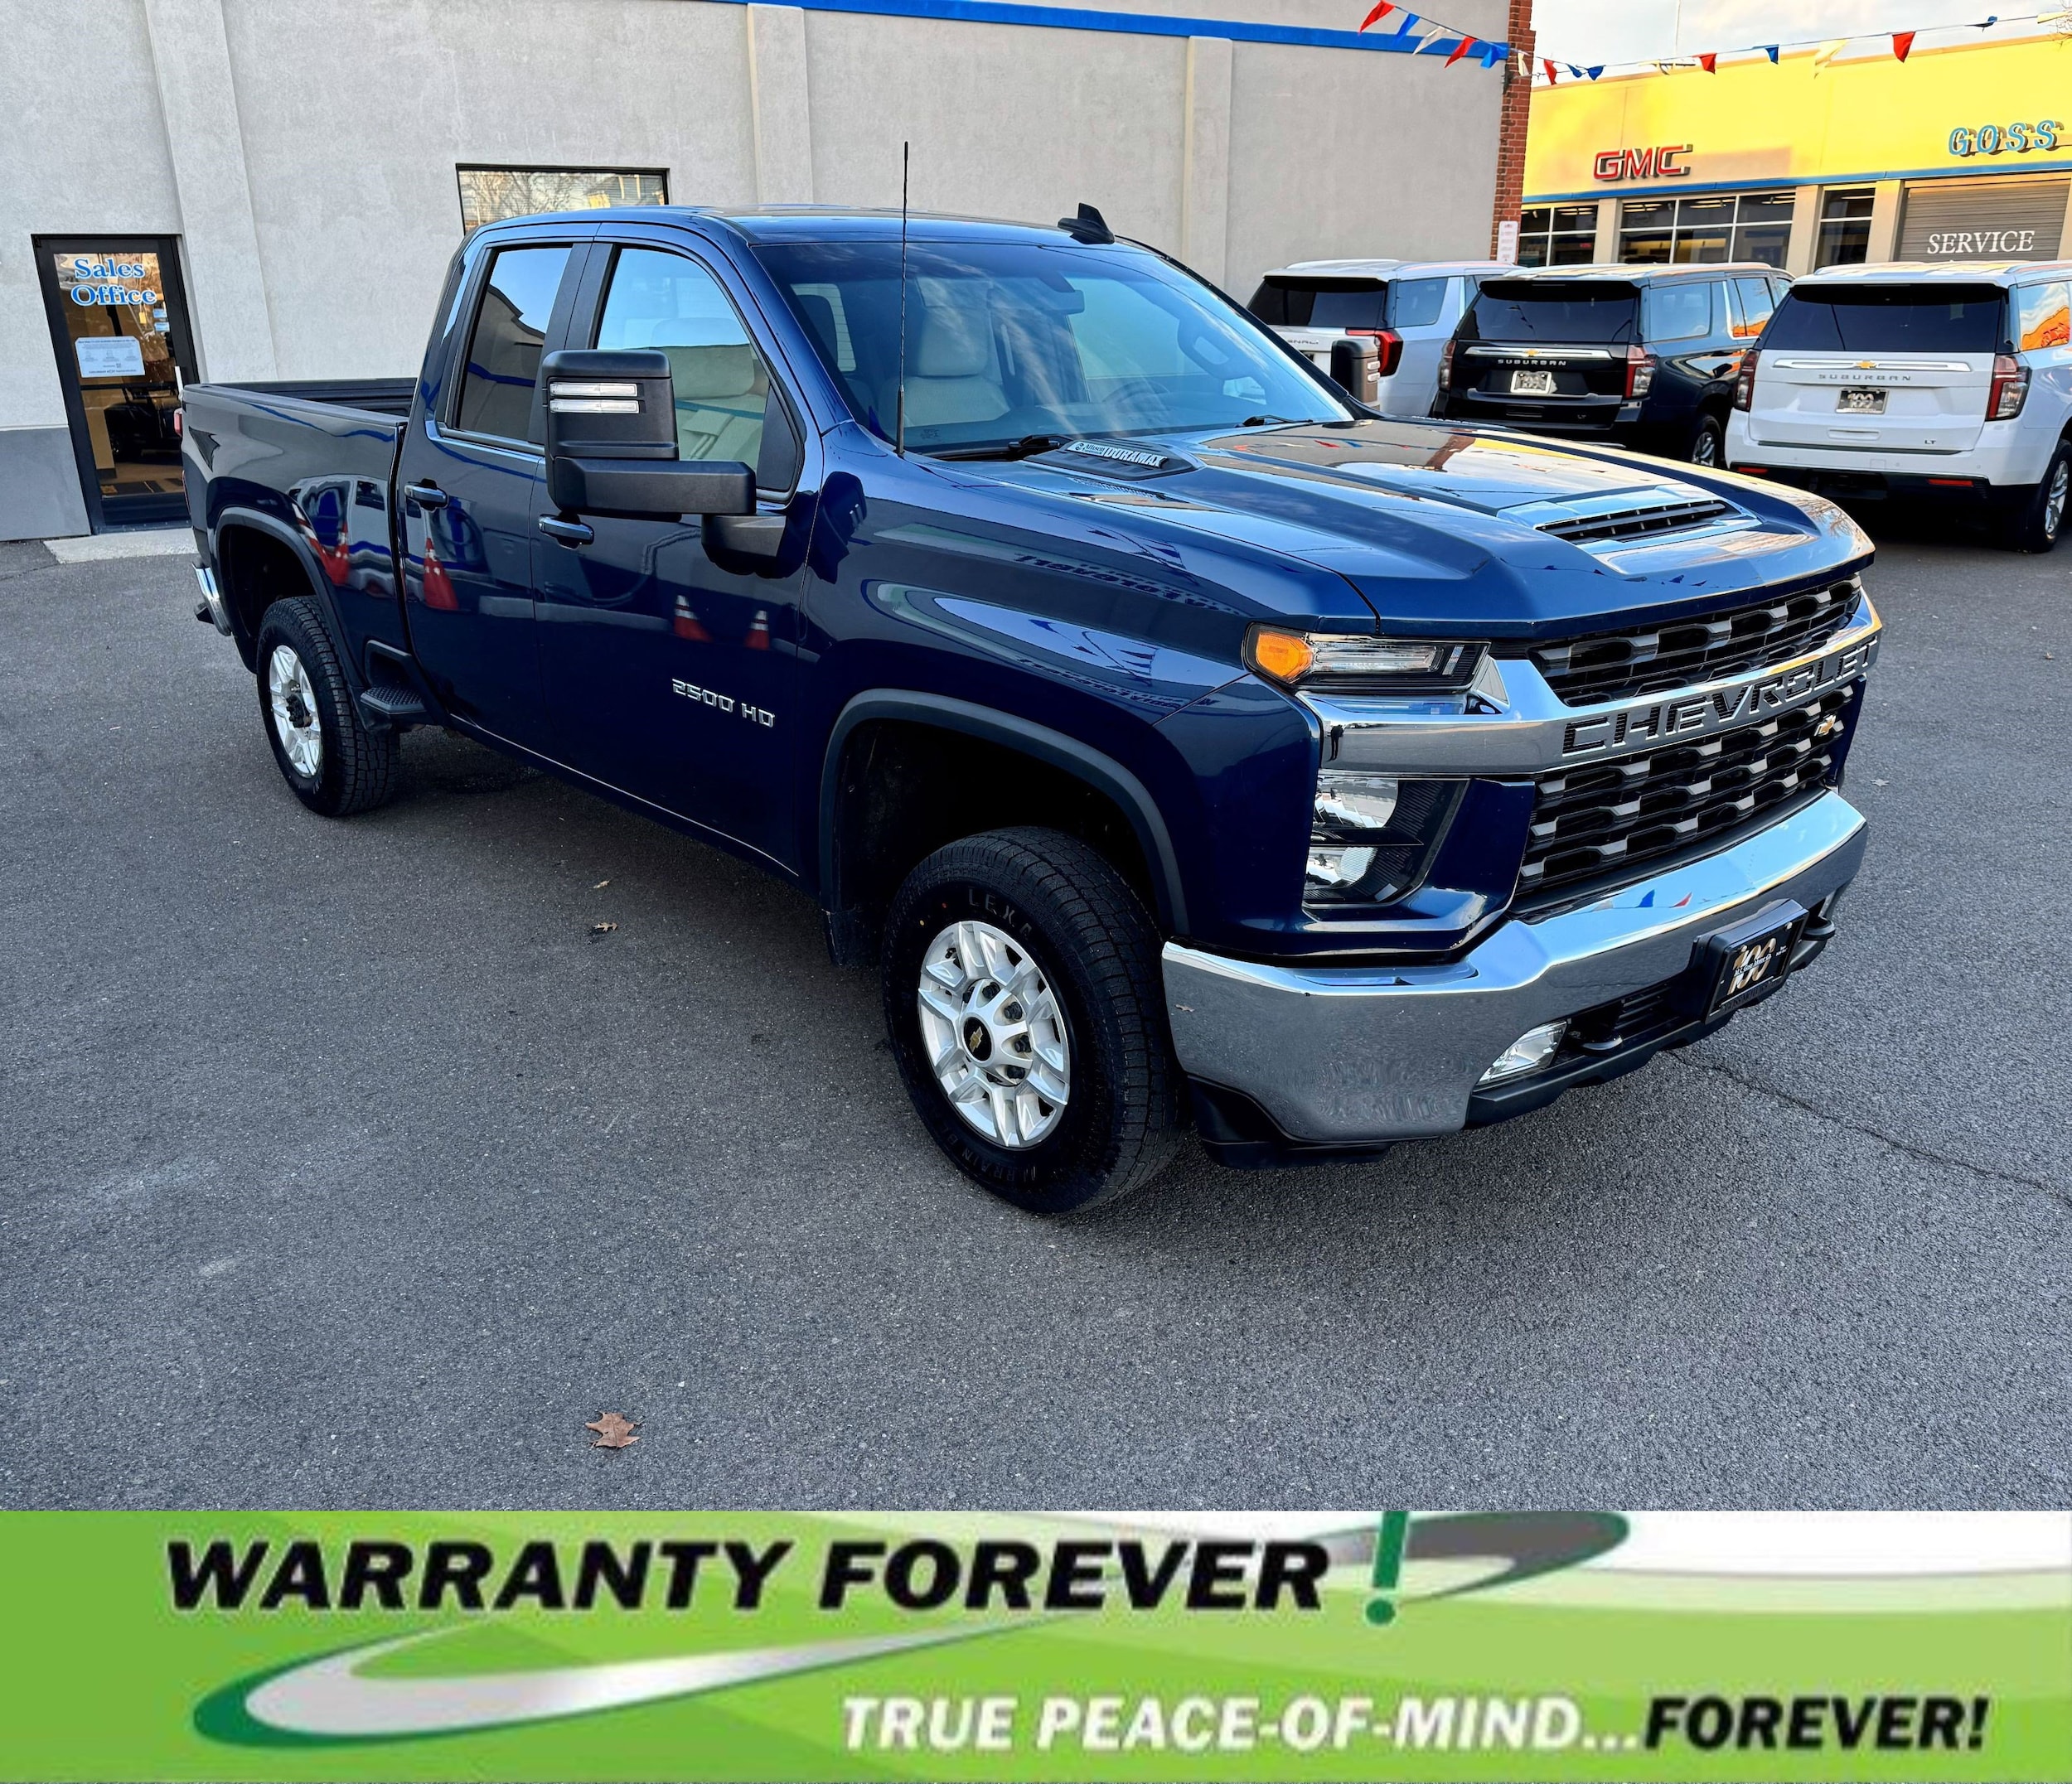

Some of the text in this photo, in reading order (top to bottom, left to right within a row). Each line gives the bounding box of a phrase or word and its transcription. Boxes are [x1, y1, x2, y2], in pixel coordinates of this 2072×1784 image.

[1949, 119, 2056, 155] GOSS
[1594, 144, 1686, 179] GMC
[1927, 230, 2036, 254] SERVICE
[73, 258, 145, 278] Sales
[70, 284, 157, 306] Office
[1104, 447, 1167, 467] DURAMAX
[672, 678, 776, 728] 2500 HD
[1562, 635, 1878, 757] CHEVROLET
